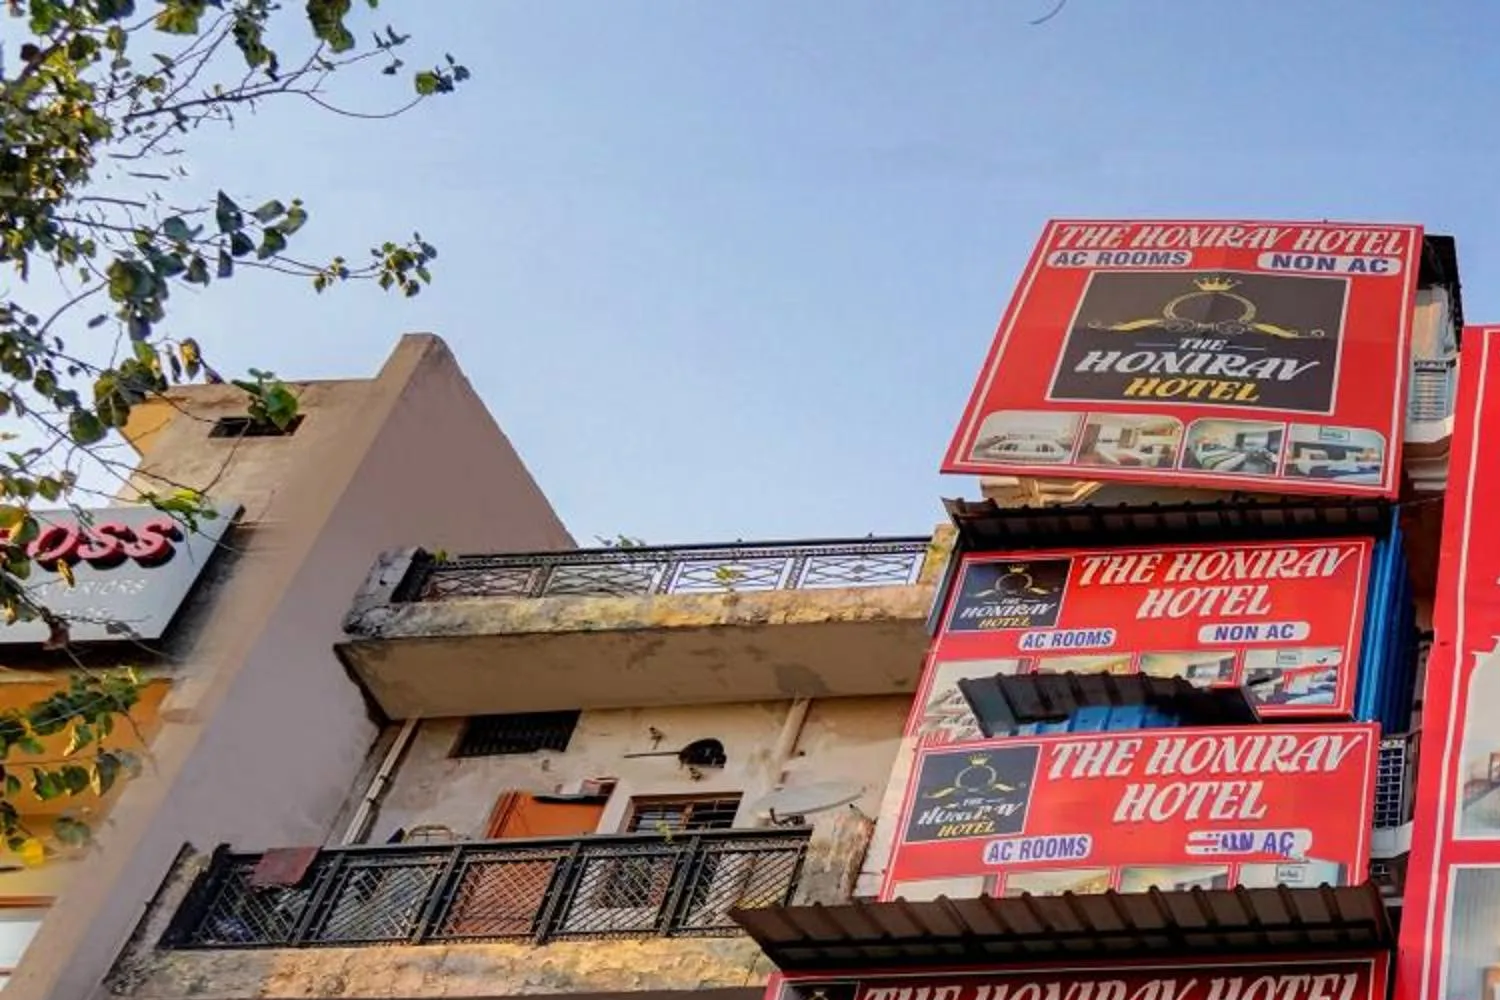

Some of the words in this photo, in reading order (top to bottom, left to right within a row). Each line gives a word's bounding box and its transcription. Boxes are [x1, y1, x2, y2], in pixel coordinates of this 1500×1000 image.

[1056, 223, 1130, 248] THE
[1131, 224, 1295, 250] HONIRAV
[1293, 226, 1404, 255] HOTEL
[1053, 251, 1094, 267] AC
[1096, 250, 1190, 267] ROOMS
[1271, 253, 1336, 272] NON
[1346, 256, 1390, 274] AC
[1177, 337, 1226, 351] THE
[1074, 350, 1320, 383] HONIRAV
[1123, 376, 1261, 402] HOTEL
[1079, 552, 1157, 586] THE
[1160, 545, 1361, 582] HONIRAV
[1136, 584, 1273, 620] HOTEL
[1022, 631, 1058, 650] AC
[1060, 628, 1114, 649] ROOMS
[1213, 624, 1264, 641] NON
[1266, 622, 1296, 640] AC
[1047, 742, 1138, 780] THE
[1145, 734, 1364, 775] HONIRAV
[1112, 781, 1268, 822] HOTEL
[936, 820, 997, 838] HOTEL
[987, 842, 1021, 863] AC
[1025, 836, 1089, 861] ROOMS
[1262, 830, 1297, 857] AC
